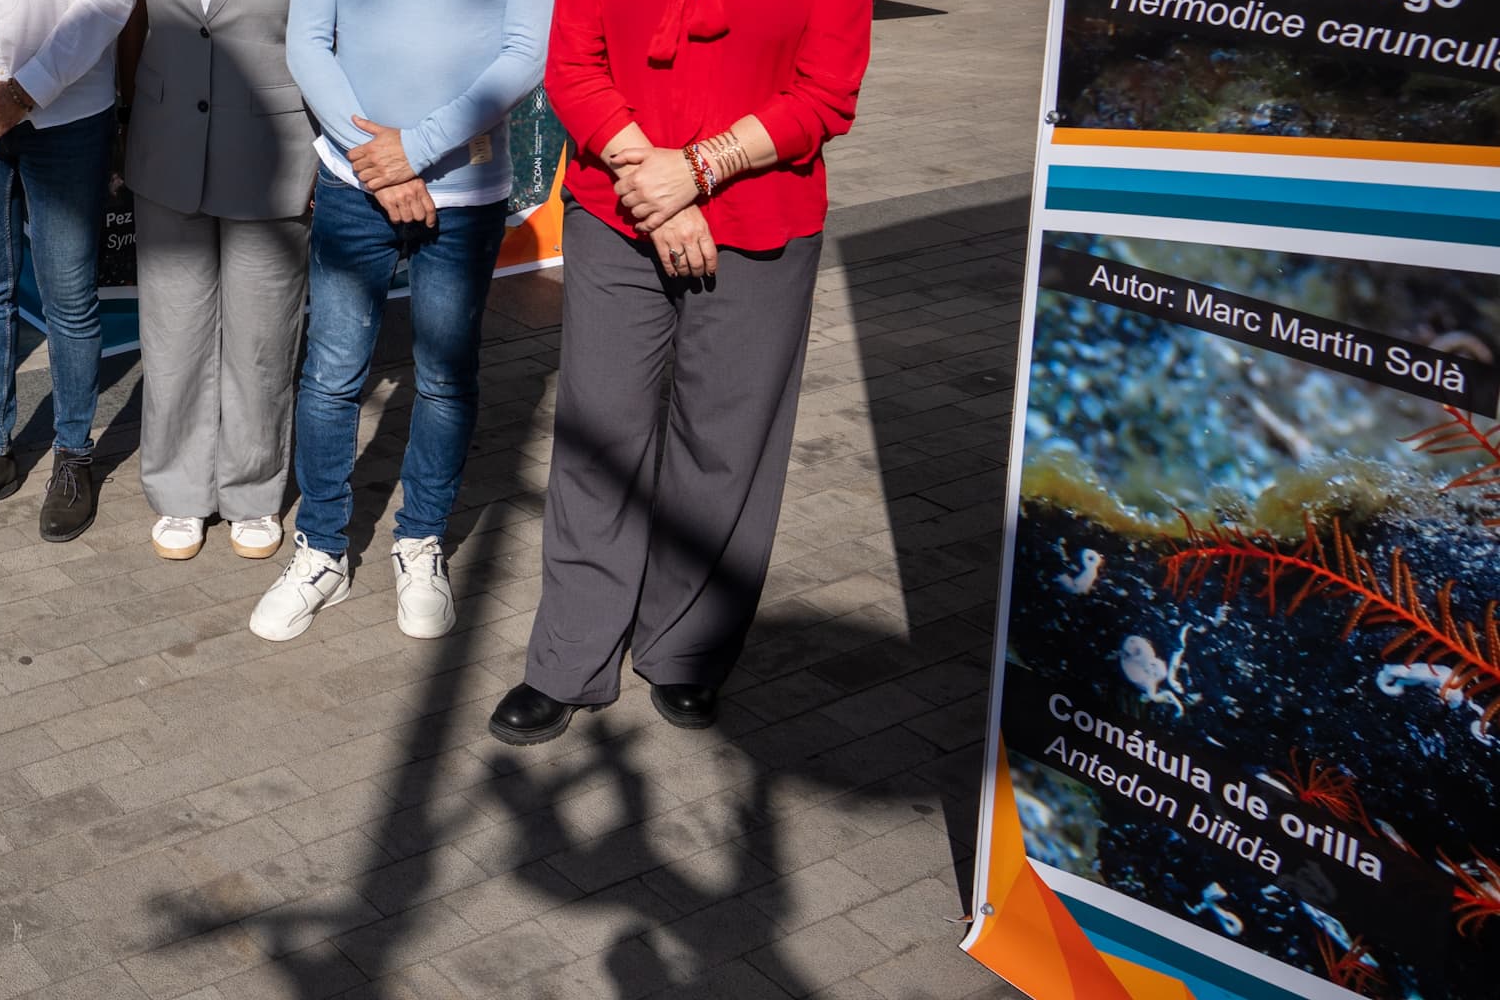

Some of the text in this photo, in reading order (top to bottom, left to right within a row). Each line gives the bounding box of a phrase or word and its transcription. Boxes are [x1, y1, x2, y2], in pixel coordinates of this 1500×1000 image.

[106, 212, 132, 228] Pez
[1089, 264, 1465, 393] Autor: Marc Martín Solà
[1043, 735, 1282, 877] Antedon bifida
[1049, 693, 1383, 882] Comátula de orilla
